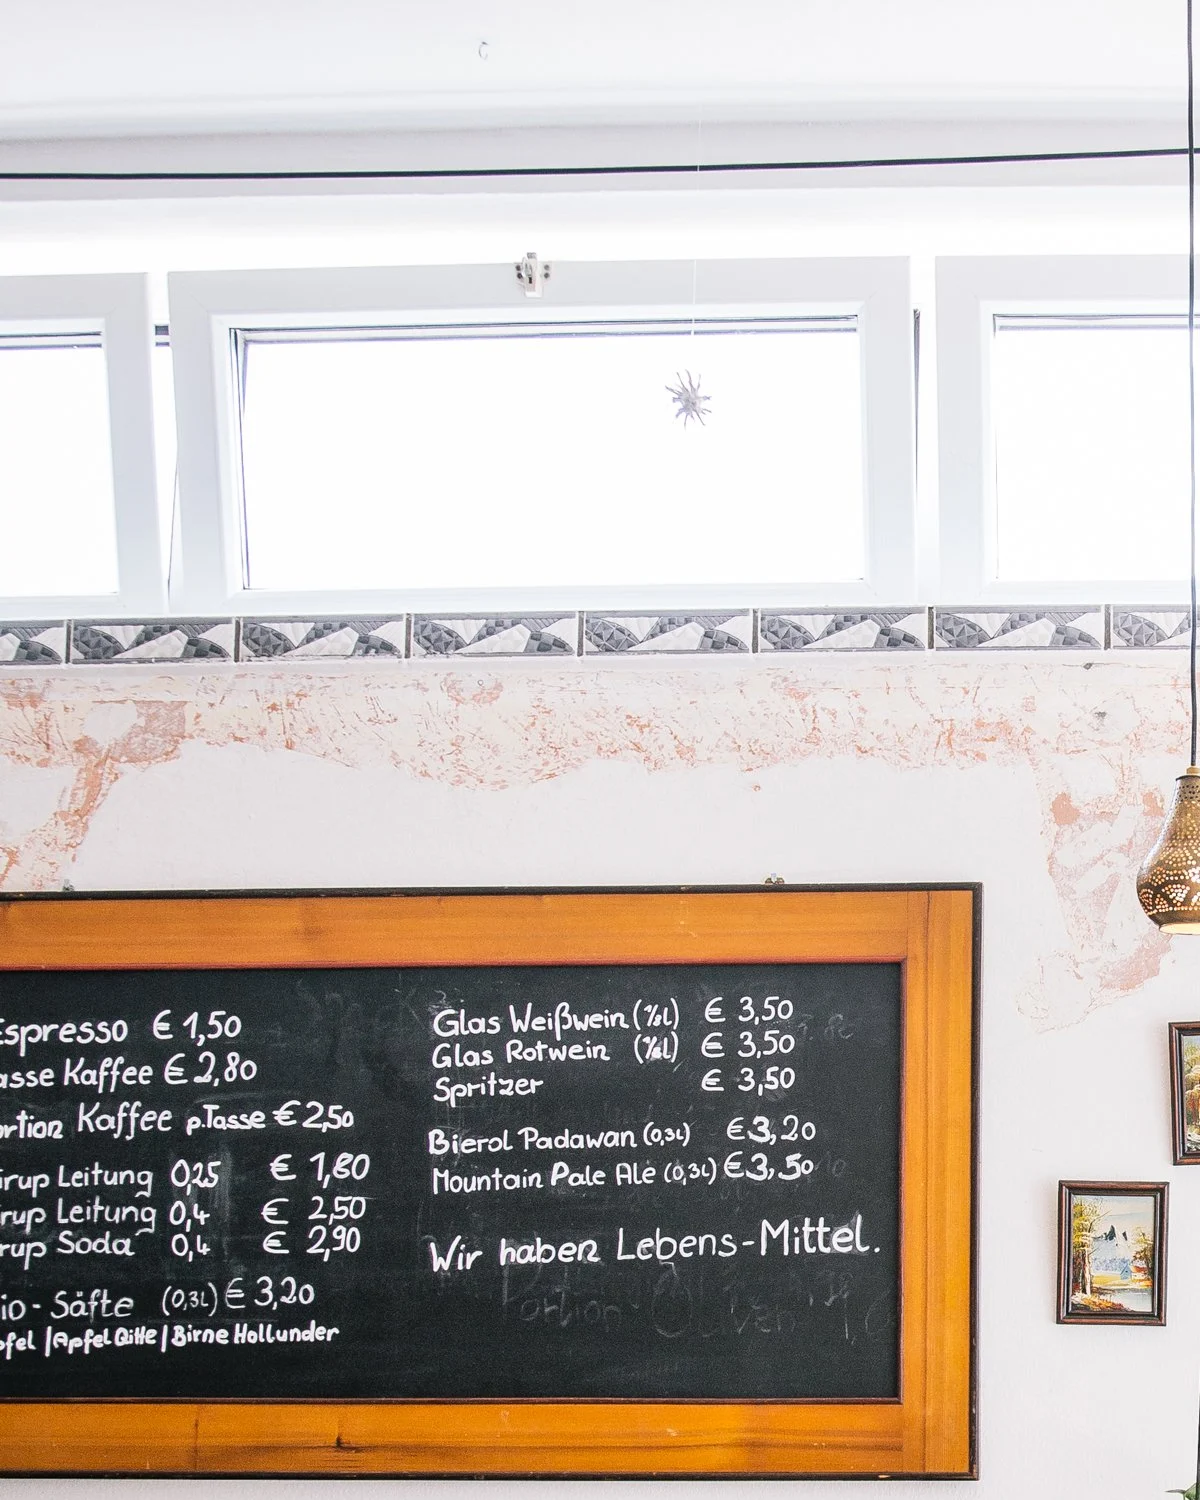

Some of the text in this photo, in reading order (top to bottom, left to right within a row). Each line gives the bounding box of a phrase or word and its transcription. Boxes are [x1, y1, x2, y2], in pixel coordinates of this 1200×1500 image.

[152, 1009, 174, 1040] €
[182, 1010, 242, 1047] 1,50
[432, 1008, 501, 1038] Glas
[508, 1001, 630, 1043] Weißwein
[704, 996, 726, 1023] €
[738, 995, 794, 1026] 3,50
[431, 1042, 494, 1069] Glas
[505, 1035, 611, 1064] Rotwein
[700, 1031, 726, 1059] €
[737, 1029, 796, 1059] 3,50
[63, 1055, 154, 1094] Kaffee
[163, 1052, 189, 1085] €
[193, 1050, 258, 1087] 2,80
[432, 1065, 796, 1108] Spritzer € 3,50
[0, 1109, 64, 1139] rtion
[77, 1100, 173, 1141] Kaffee
[427, 1128, 514, 1156] Bierol
[517, 1126, 638, 1151] Padawan
[58, 1161, 154, 1200] Leitung
[170, 1158, 222, 1196] 0,25
[269, 1153, 297, 1181] €
[432, 1167, 544, 1195] Mountain
[550, 1161, 607, 1187] Pale
[615, 1159, 657, 1186] Ale
[0, 1195, 367, 1236] rup Leitung 0,4 € 2,50
[56, 1230, 136, 1257] Soda
[171, 1233, 211, 1263] 0,4
[262, 1230, 290, 1254] €
[306, 1224, 361, 1262] 2,90
[429, 1234, 483, 1273] Wir
[499, 1236, 602, 1267] haben
[50, 1288, 134, 1323] Säfte
[225, 1277, 246, 1309] €
[254, 1275, 315, 1311] 3,20
[170, 1324, 230, 1347] Birne
[233, 1319, 340, 1345] Hollunder
